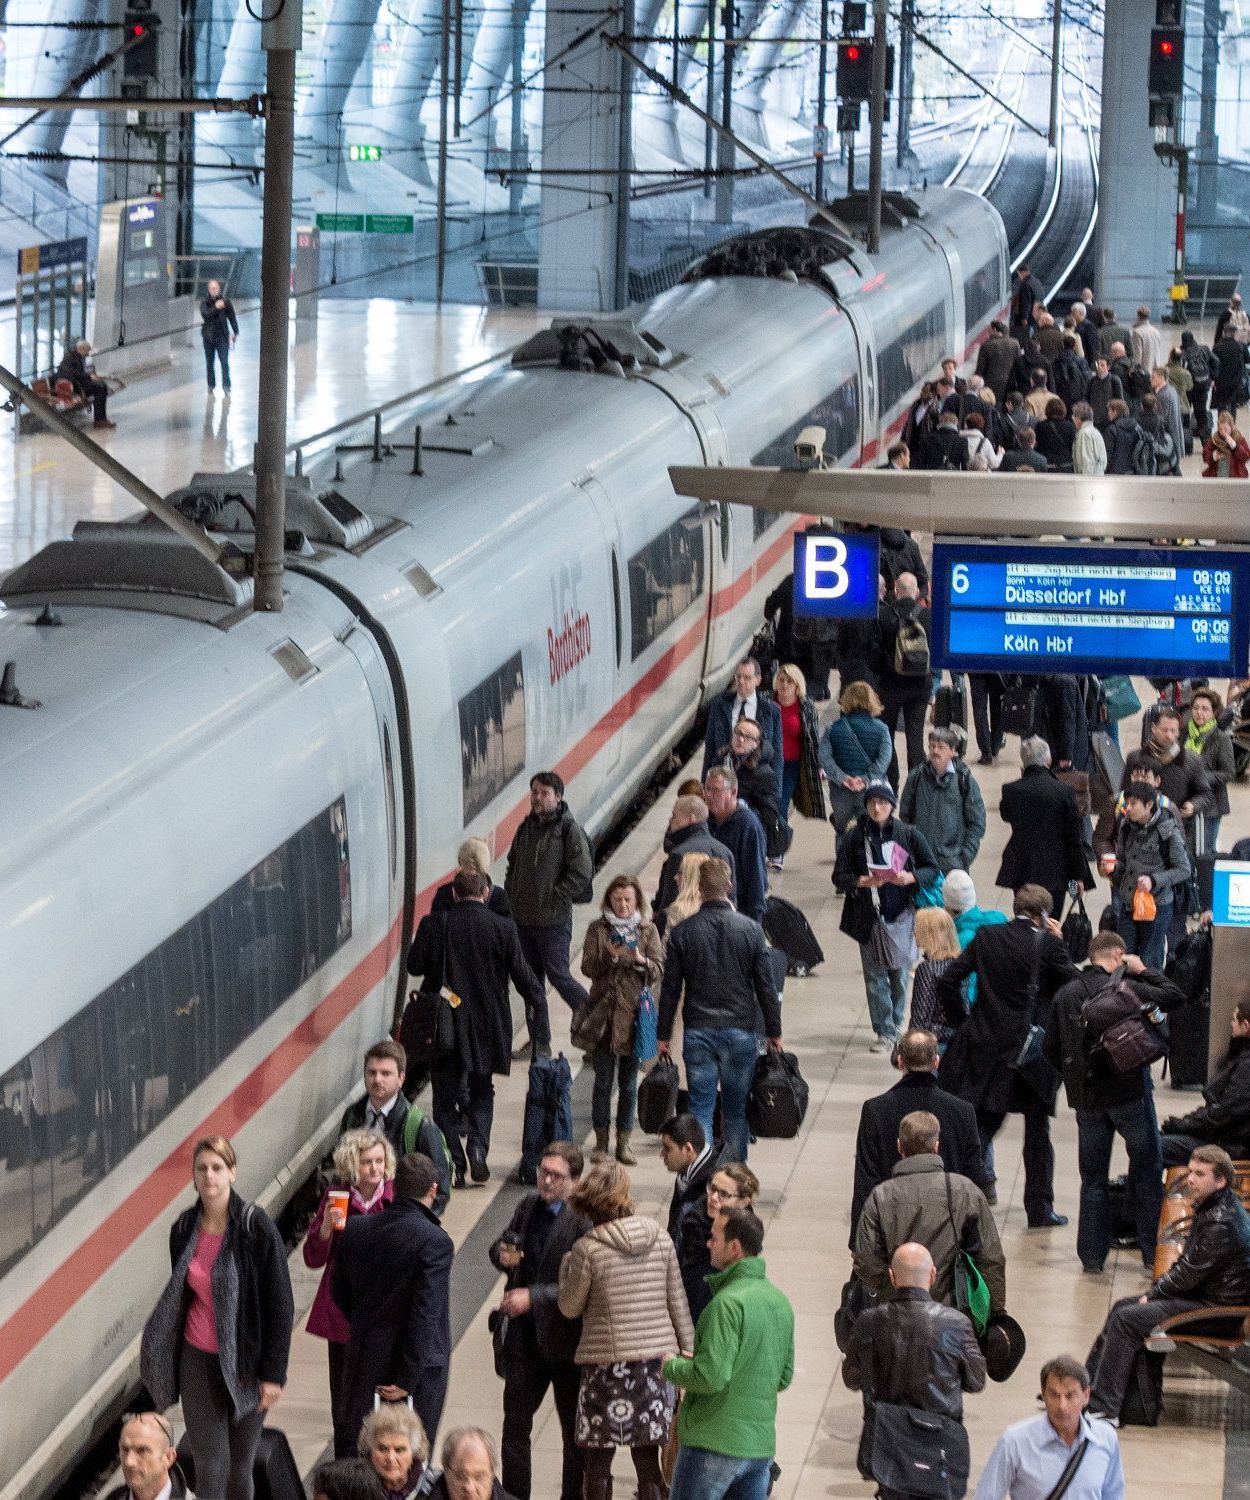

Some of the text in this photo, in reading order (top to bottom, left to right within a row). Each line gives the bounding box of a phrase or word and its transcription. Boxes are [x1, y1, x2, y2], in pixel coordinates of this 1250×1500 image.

[805, 535, 849, 599] B
[952, 563, 970, 594] 6
[1193, 570, 1230, 585] 09:09
[1005, 585, 1127, 606] Düsseldorf Hbf
[1192, 619, 1229, 634] 09:09
[1004, 634, 1074, 653] Köln Hbf
